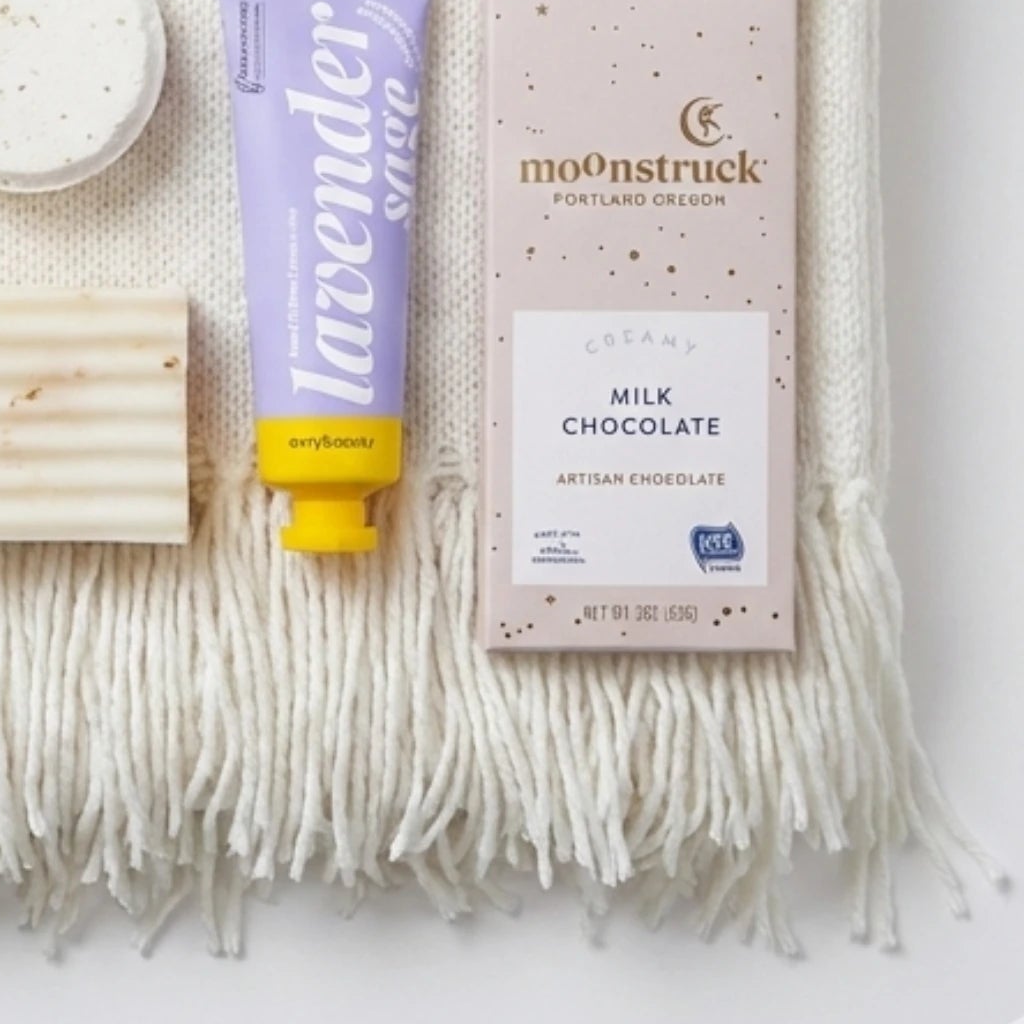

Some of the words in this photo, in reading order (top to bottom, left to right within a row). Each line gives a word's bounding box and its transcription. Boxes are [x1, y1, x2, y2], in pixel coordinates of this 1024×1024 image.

[382, 78, 419, 228] sage
[520, 149, 762, 184] moonstruck
[285, 1, 375, 406] lavender
[610, 387, 672, 405] MILK
[562, 418, 720, 435] CHOCOLATE
[556, 473, 624, 486] ARTISAN
